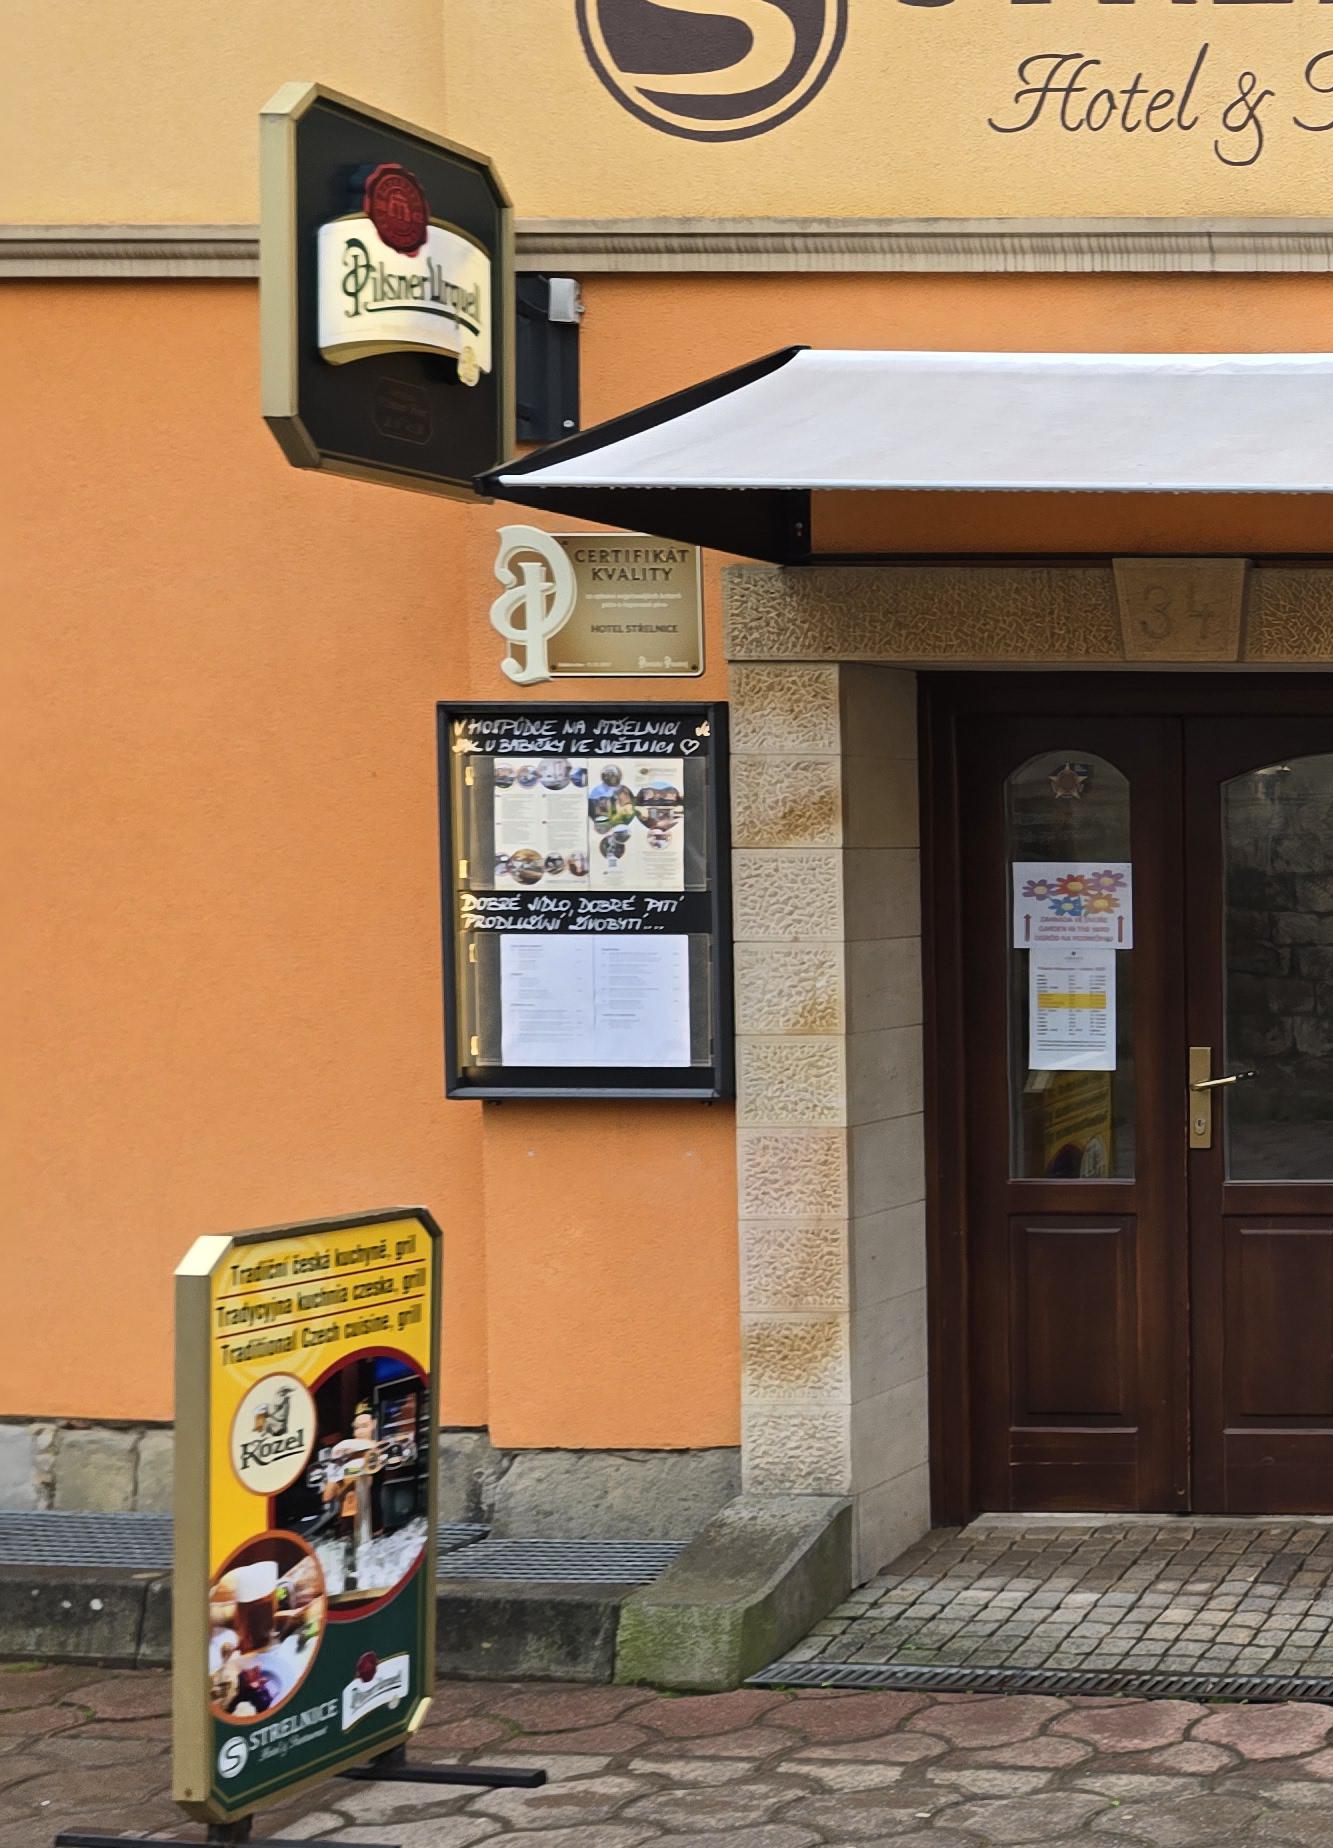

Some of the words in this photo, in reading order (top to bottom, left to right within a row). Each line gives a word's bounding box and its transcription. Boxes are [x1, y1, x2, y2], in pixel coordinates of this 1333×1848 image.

[987, 42, 1209, 135] Hotel
[1213, 72, 1270, 167] &
[342, 237, 428, 318] Pilsner
[574, 546, 689, 563] CERTIFIKÁT
[592, 567, 673, 581] KVALITY
[591, 624, 623, 633] HOTEL
[563, 719, 585, 736] NA
[570, 739, 594, 753] VE
[578, 895, 636, 912] DOBRÉ
